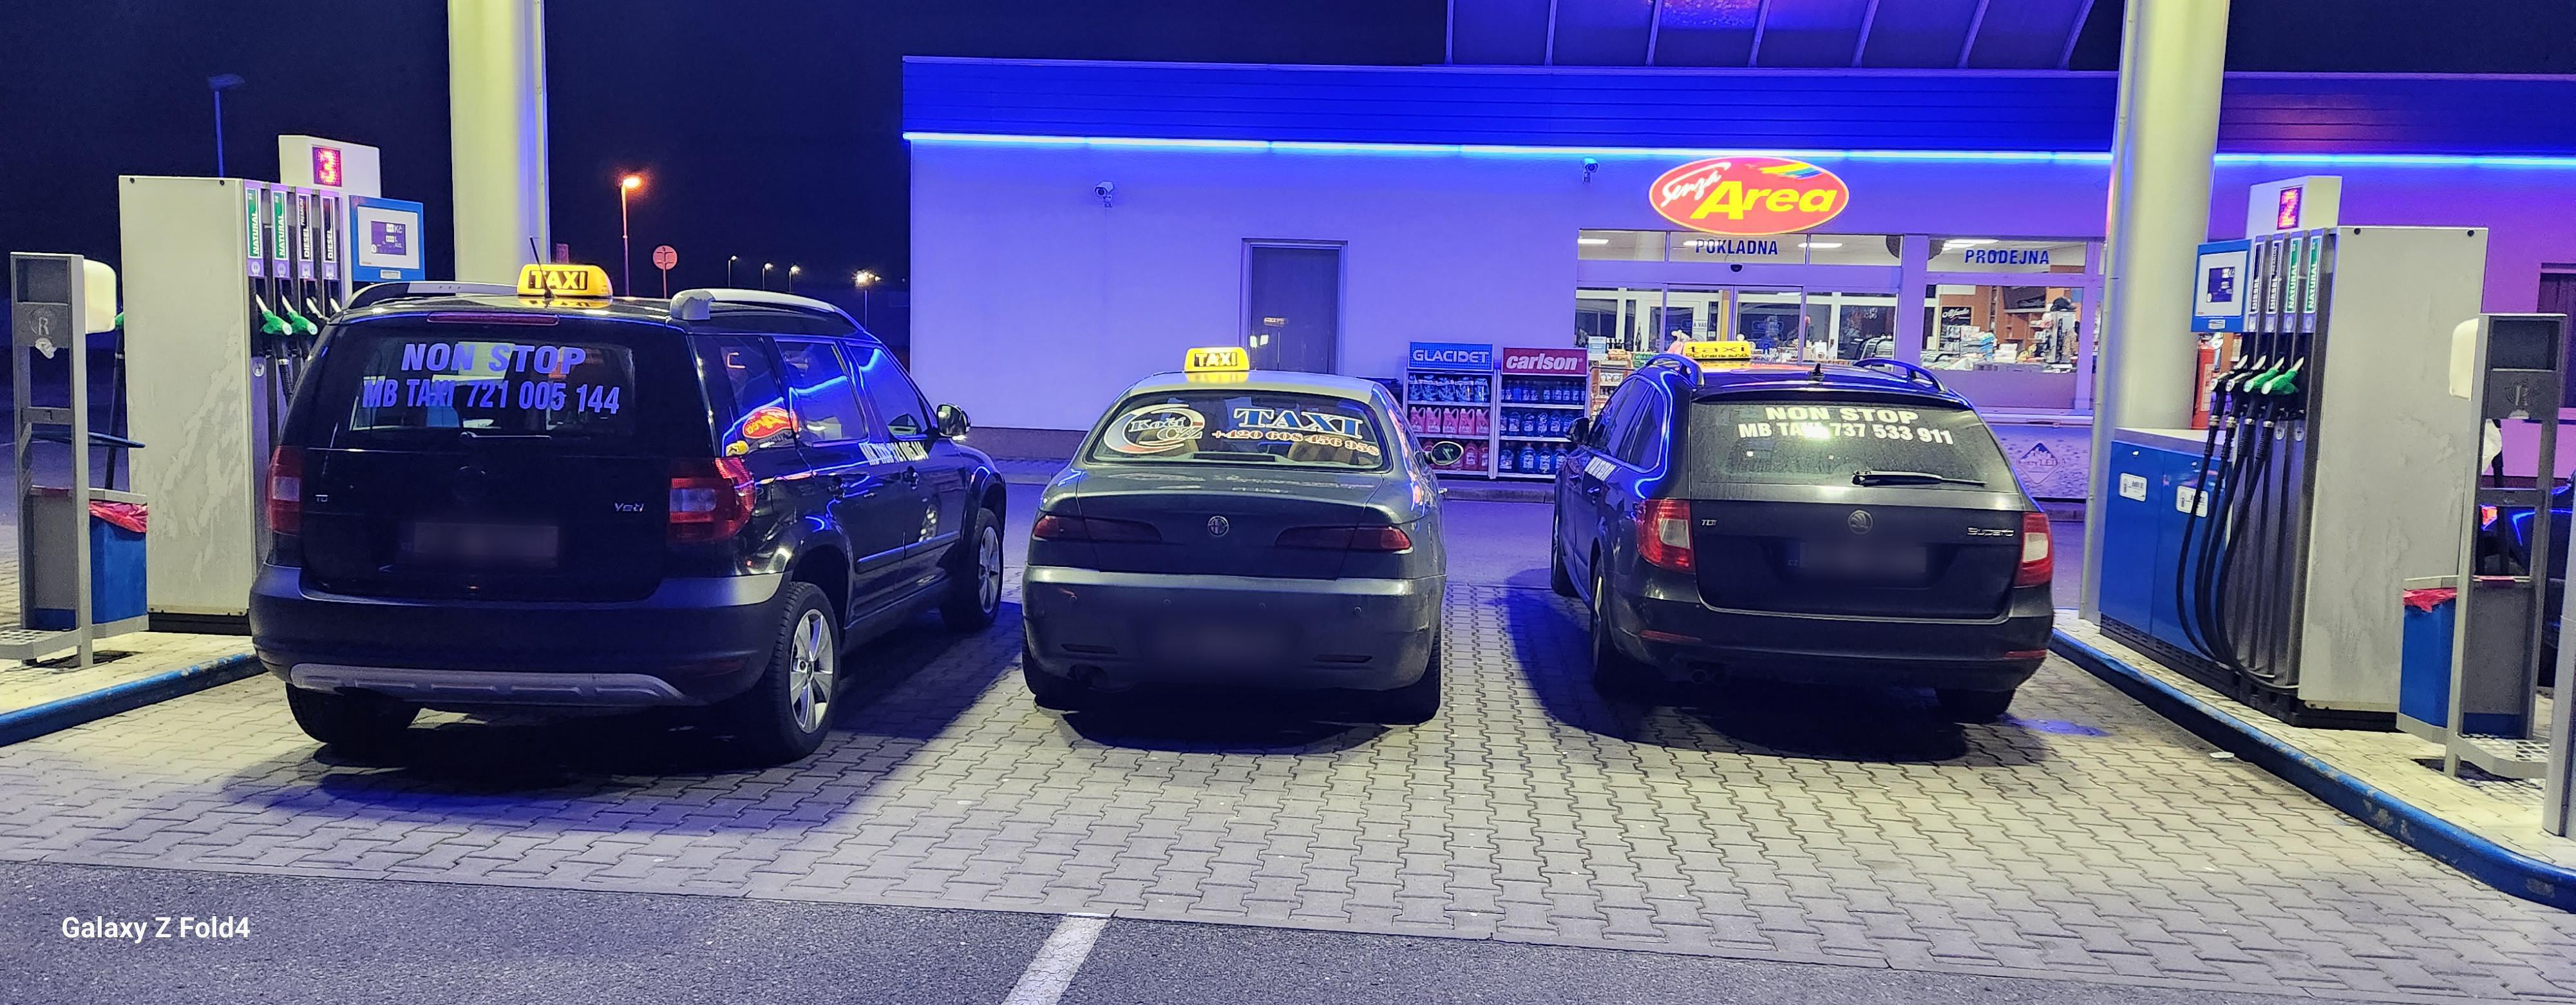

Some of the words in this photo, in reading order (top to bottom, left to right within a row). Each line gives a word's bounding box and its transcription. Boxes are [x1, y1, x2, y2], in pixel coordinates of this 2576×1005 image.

[318, 149, 337, 184] 3
[1690, 180, 1837, 220] Area
[2279, 189, 2298, 228] 2
[1695, 239, 1778, 255] POKLADNA
[1965, 249, 2050, 265] PRODEJNA
[531, 270, 587, 291] TAXI
[2288, 262, 2298, 309] NATURAL
[2307, 262, 2317, 309] NATURAL
[401, 343, 476, 372] NON
[488, 345, 587, 374] STOP
[1195, 352, 1237, 367] TAXI
[1412, 349, 1489, 364] GLACIDET
[1506, 353, 1578, 370] carlson
[362, 379, 398, 408] MB
[407, 379, 455, 407] TAXI
[466, 380, 509, 408] 721
[519, 381, 567, 412] 005
[576, 384, 620, 414] 144
[1233, 408, 1363, 439] TAXI
[1765, 407, 1831, 420] NON
[1839, 407, 1919, 424] STOP
[1211, 429, 1264, 439] +420
[1265, 430, 1304, 443] 608
[1305, 434, 1343, 447] 456
[1738, 423, 1772, 438] MB
[1830, 423, 1866, 437] 737
[1871, 423, 1914, 441] 533
[1917, 427, 1954, 445] 911
[614, 503, 644, 512] Yeti
